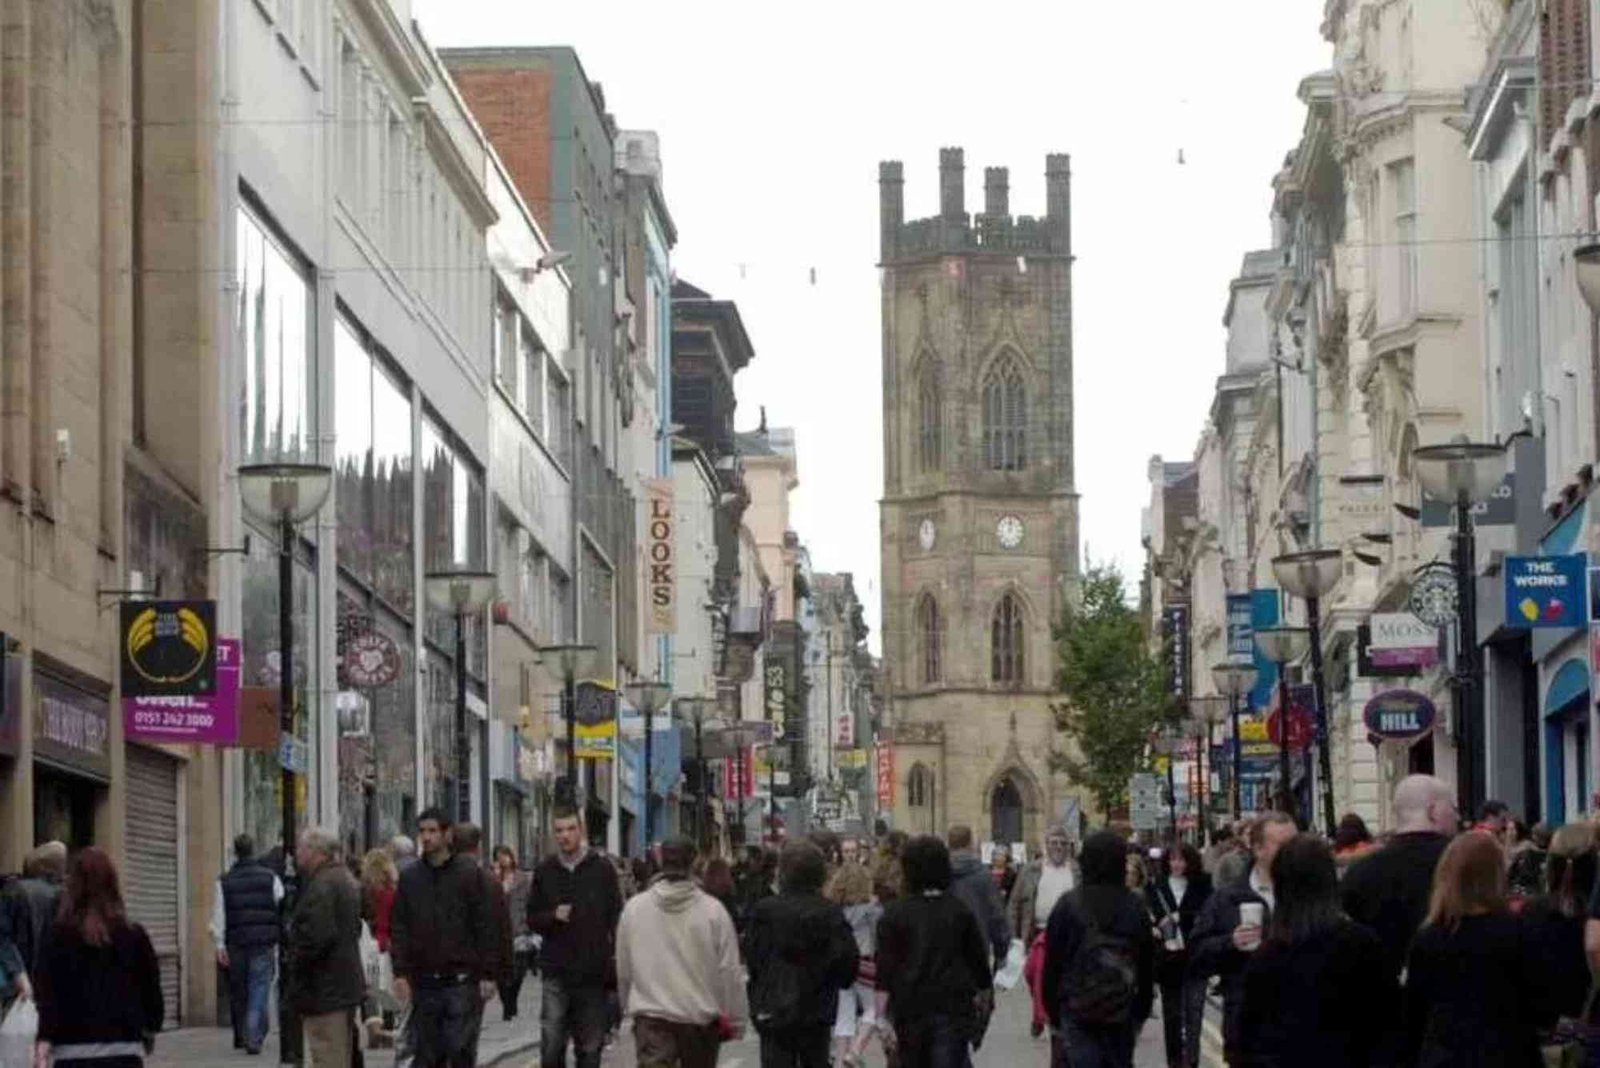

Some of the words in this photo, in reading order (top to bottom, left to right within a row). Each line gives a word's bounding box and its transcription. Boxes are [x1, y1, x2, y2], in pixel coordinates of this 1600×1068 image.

[650, 498, 672, 607] LOOKS
[1526, 561, 1555, 574] THE
[1513, 574, 1568, 588] WORKS
[1380, 711, 1421, 732] HILL
